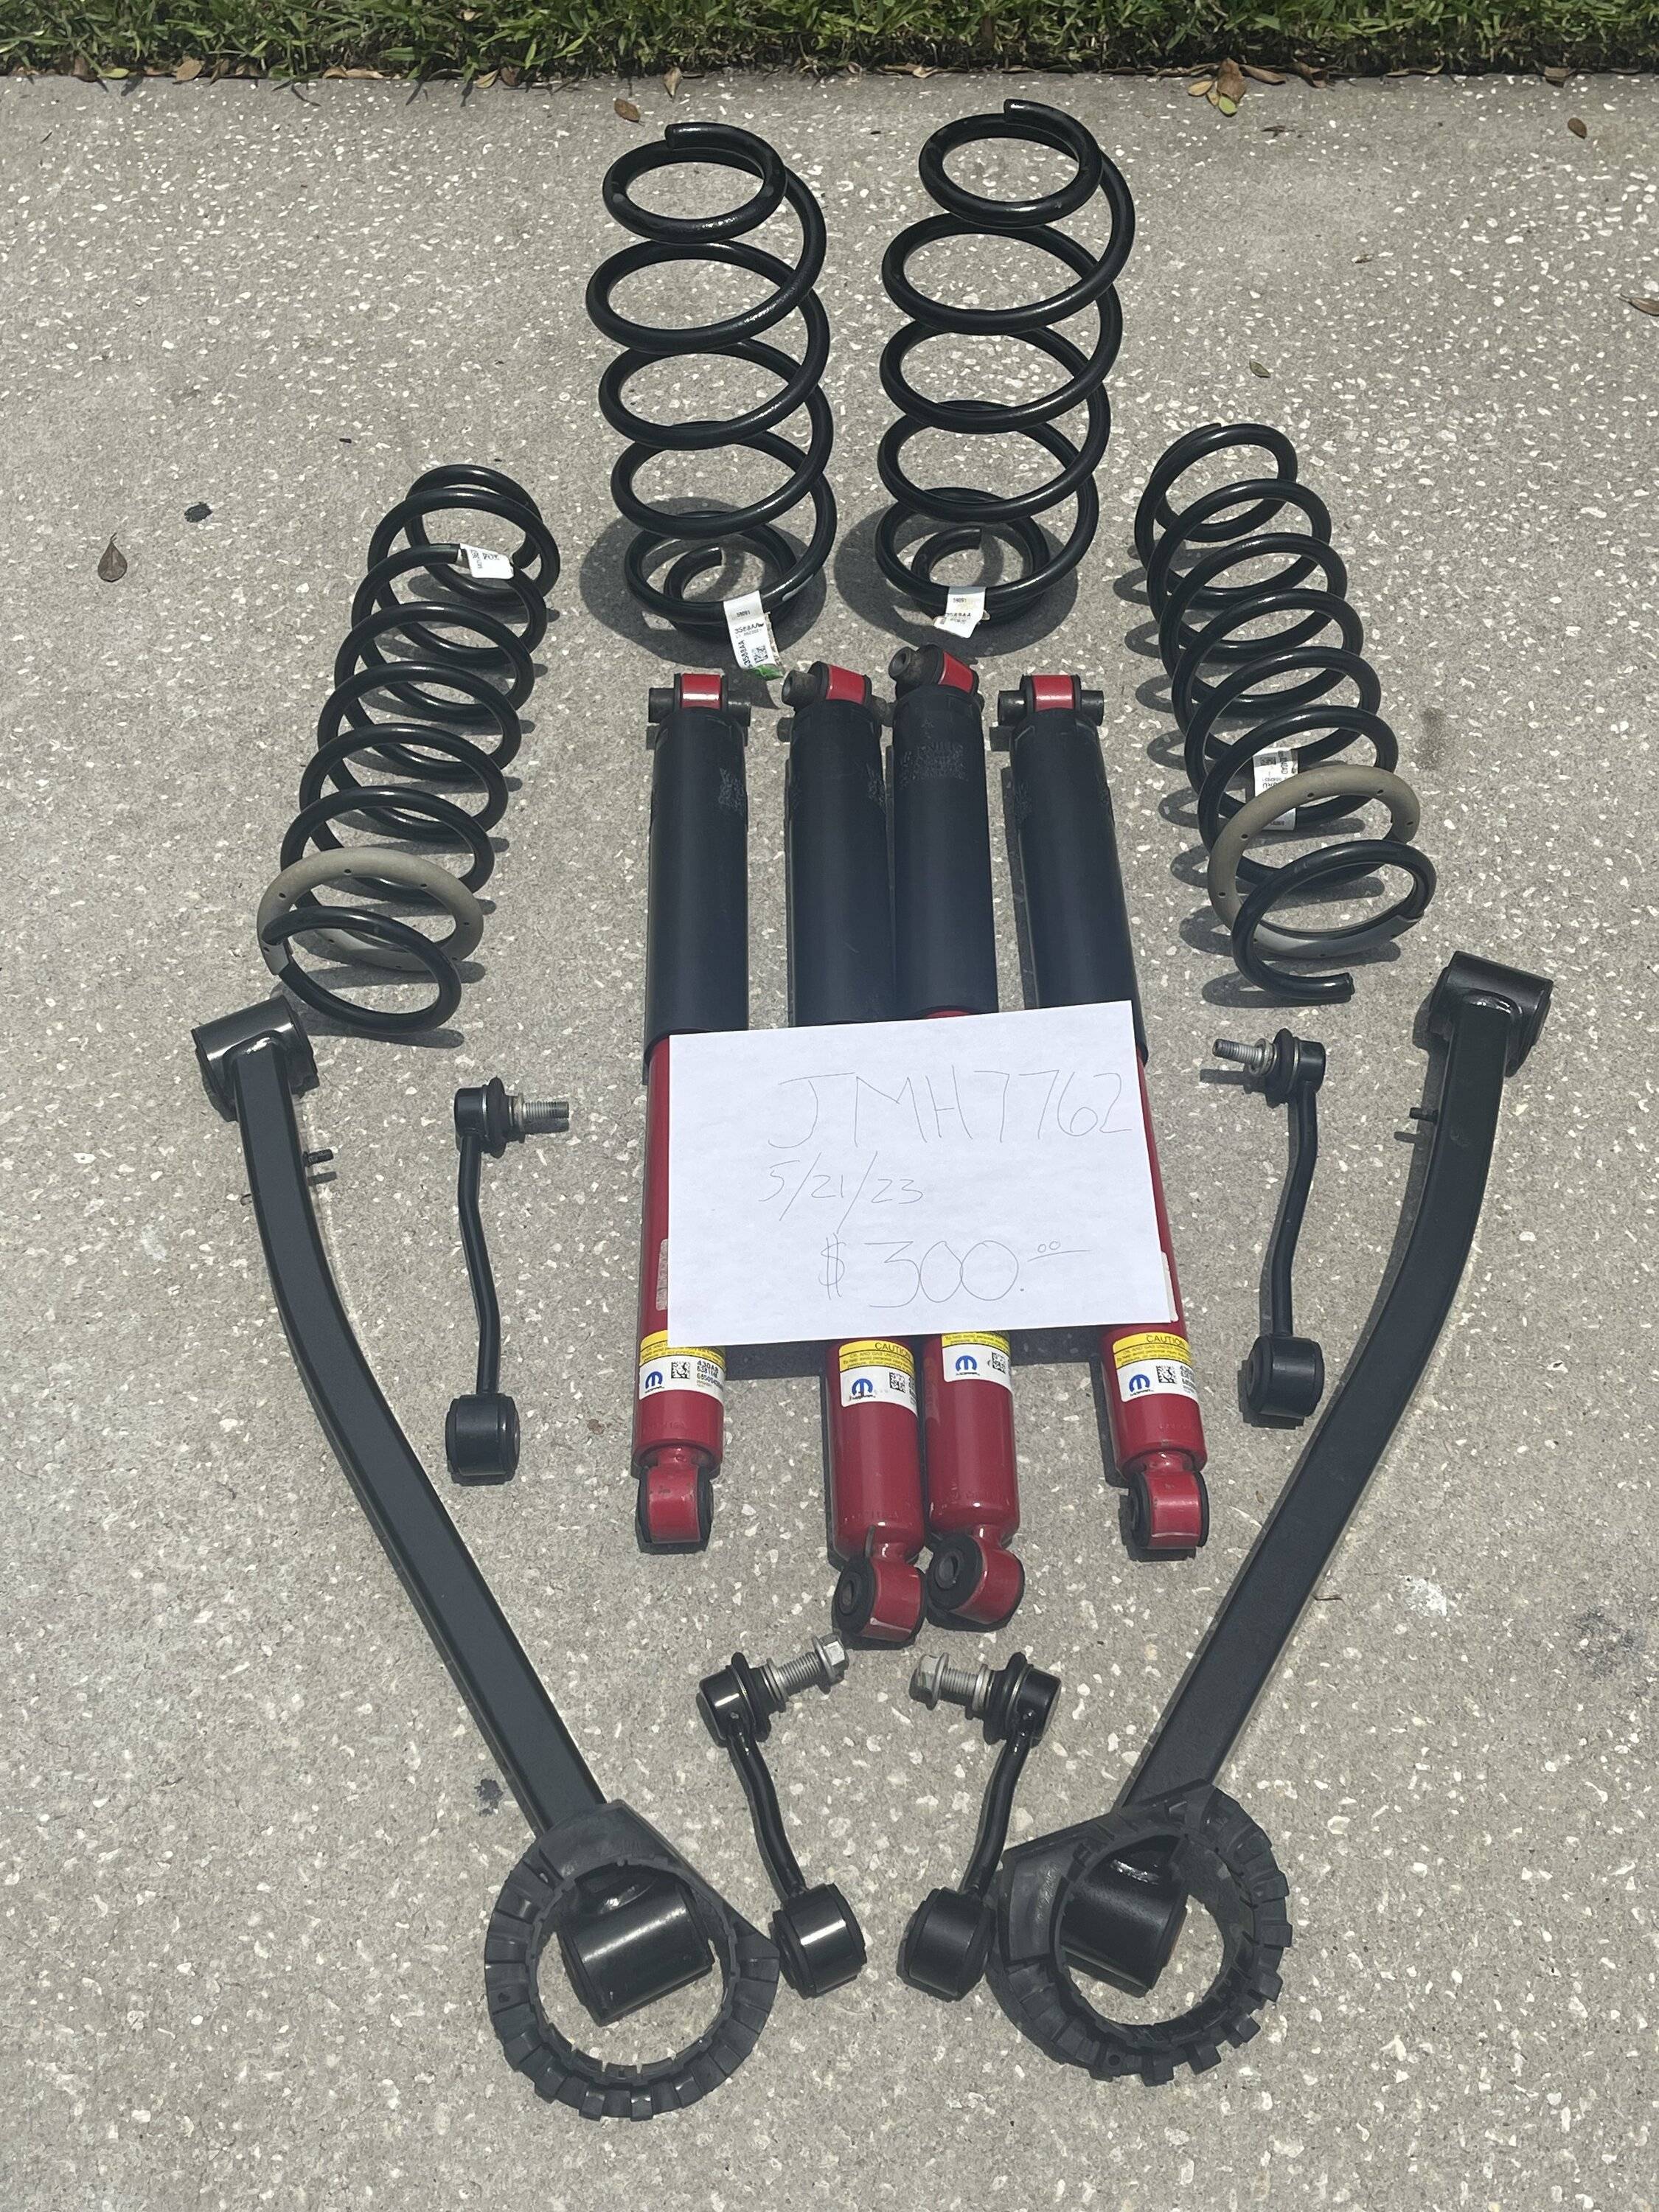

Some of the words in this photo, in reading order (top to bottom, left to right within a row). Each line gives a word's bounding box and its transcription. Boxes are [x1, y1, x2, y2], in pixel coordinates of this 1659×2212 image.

[767, 1065, 1133, 1149] JMH7762
[759, 1151, 924, 1234] 5/21/23
[874, 1342, 911, 1359] CAUTION
[1146, 1335, 1186, 1347] CAUTION
